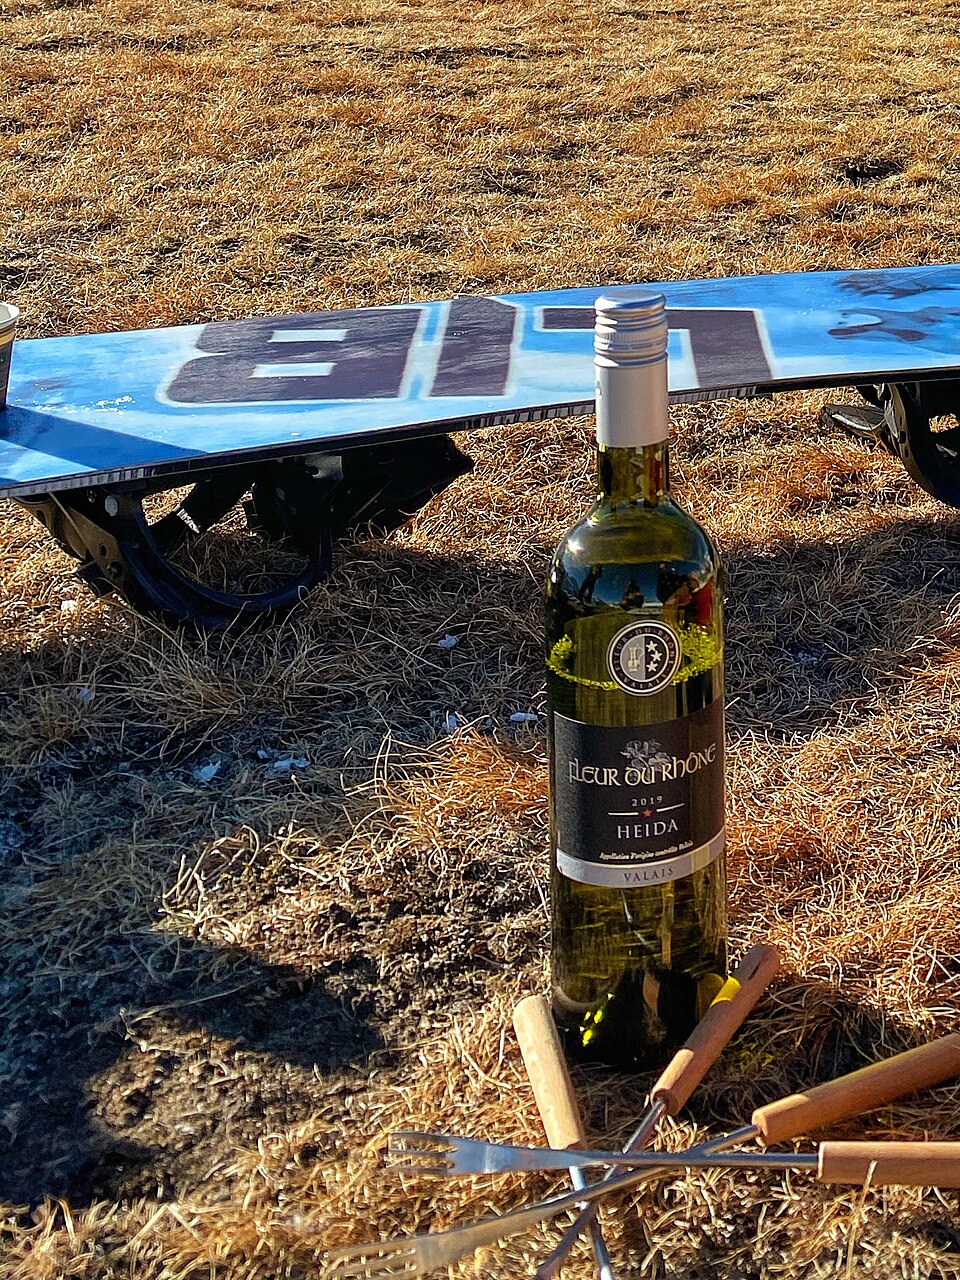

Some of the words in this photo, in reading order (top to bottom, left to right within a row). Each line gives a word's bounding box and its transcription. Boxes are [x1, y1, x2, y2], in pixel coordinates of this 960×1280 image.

[624, 766, 655, 787] DU
[631, 795, 663, 807] 2019
[617, 819, 679, 839] HEIDA
[624, 867, 674, 882] VALAIS
